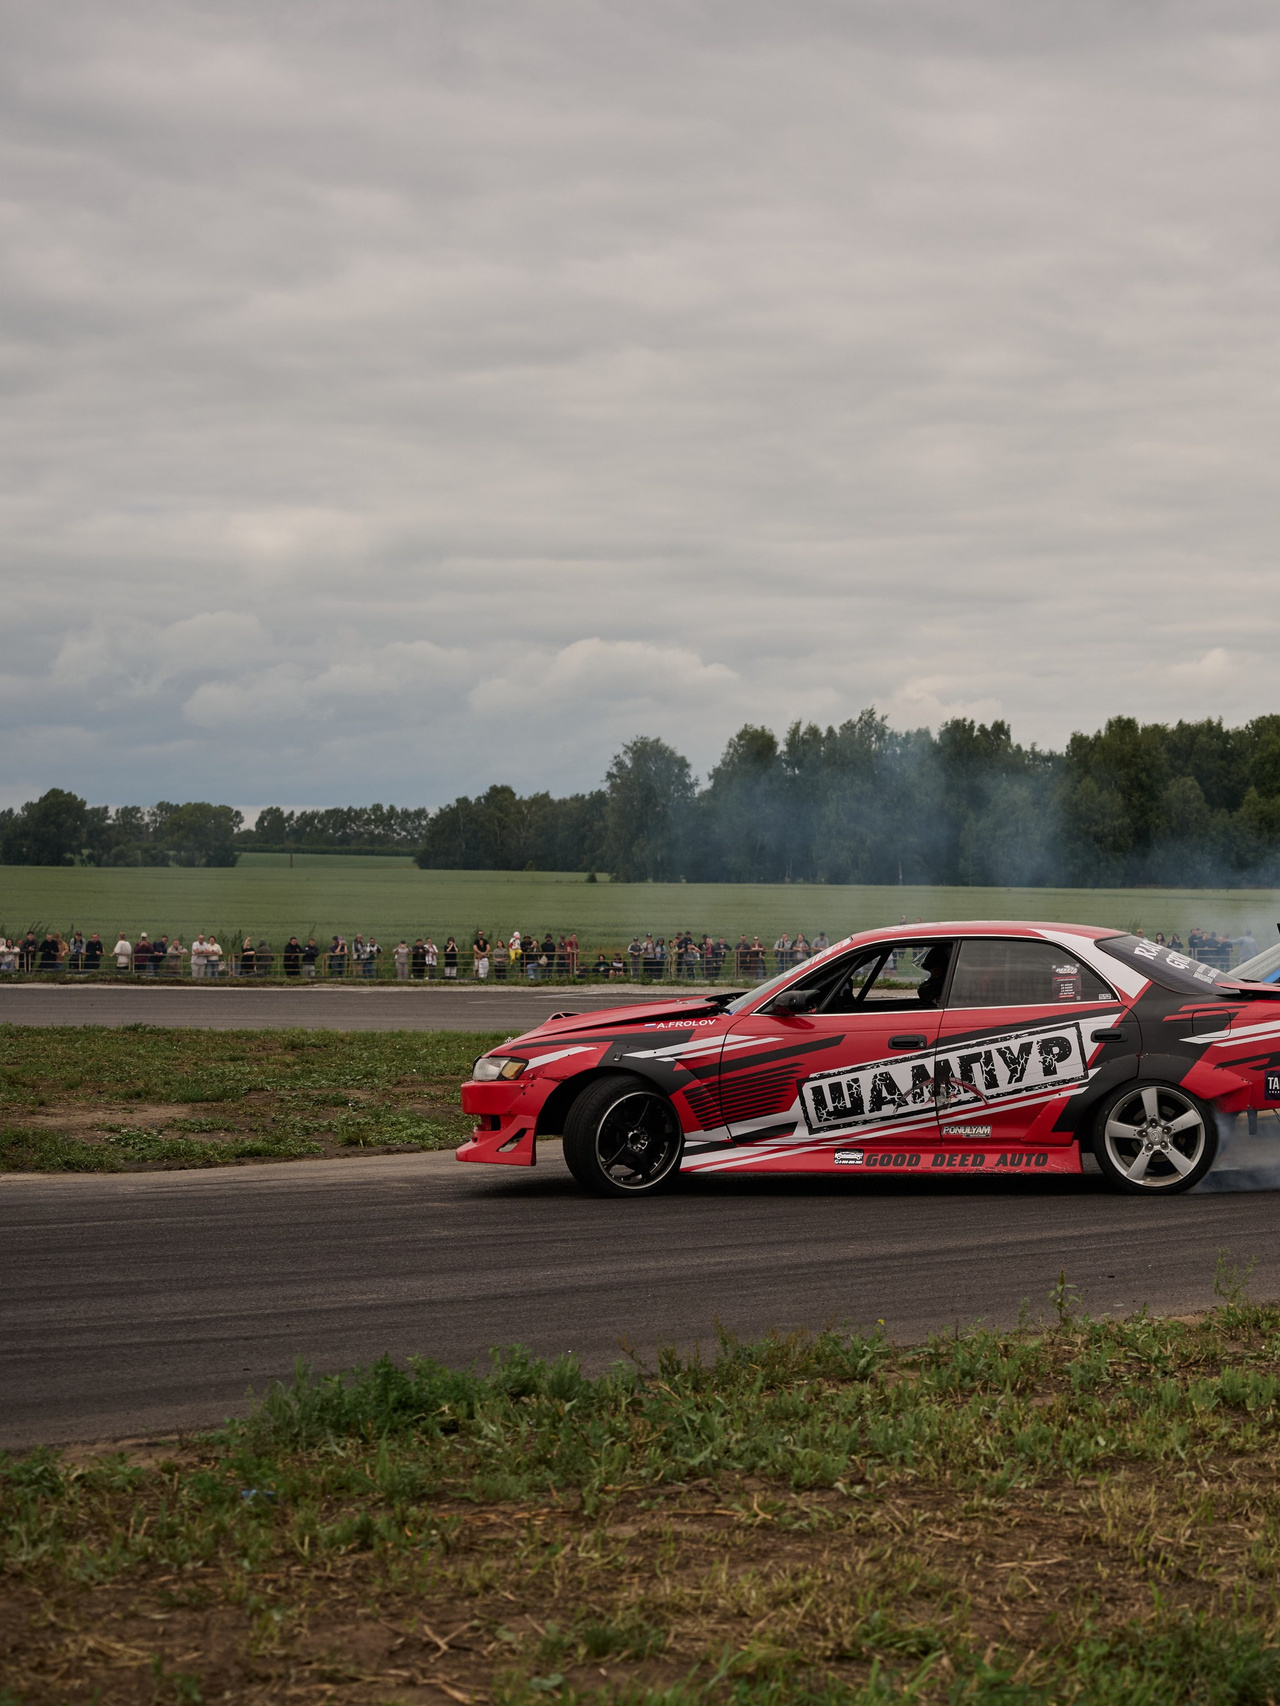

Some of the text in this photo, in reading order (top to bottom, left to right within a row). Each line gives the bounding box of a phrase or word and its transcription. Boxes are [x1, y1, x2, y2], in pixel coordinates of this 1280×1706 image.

[656, 1019, 716, 1029] A.FROLOV
[809, 1036, 1072, 1123] ШАМПУР
[942, 1126, 991, 1135] PONULYAM
[865, 1153, 1049, 1167] GOOD DEED AUTO
